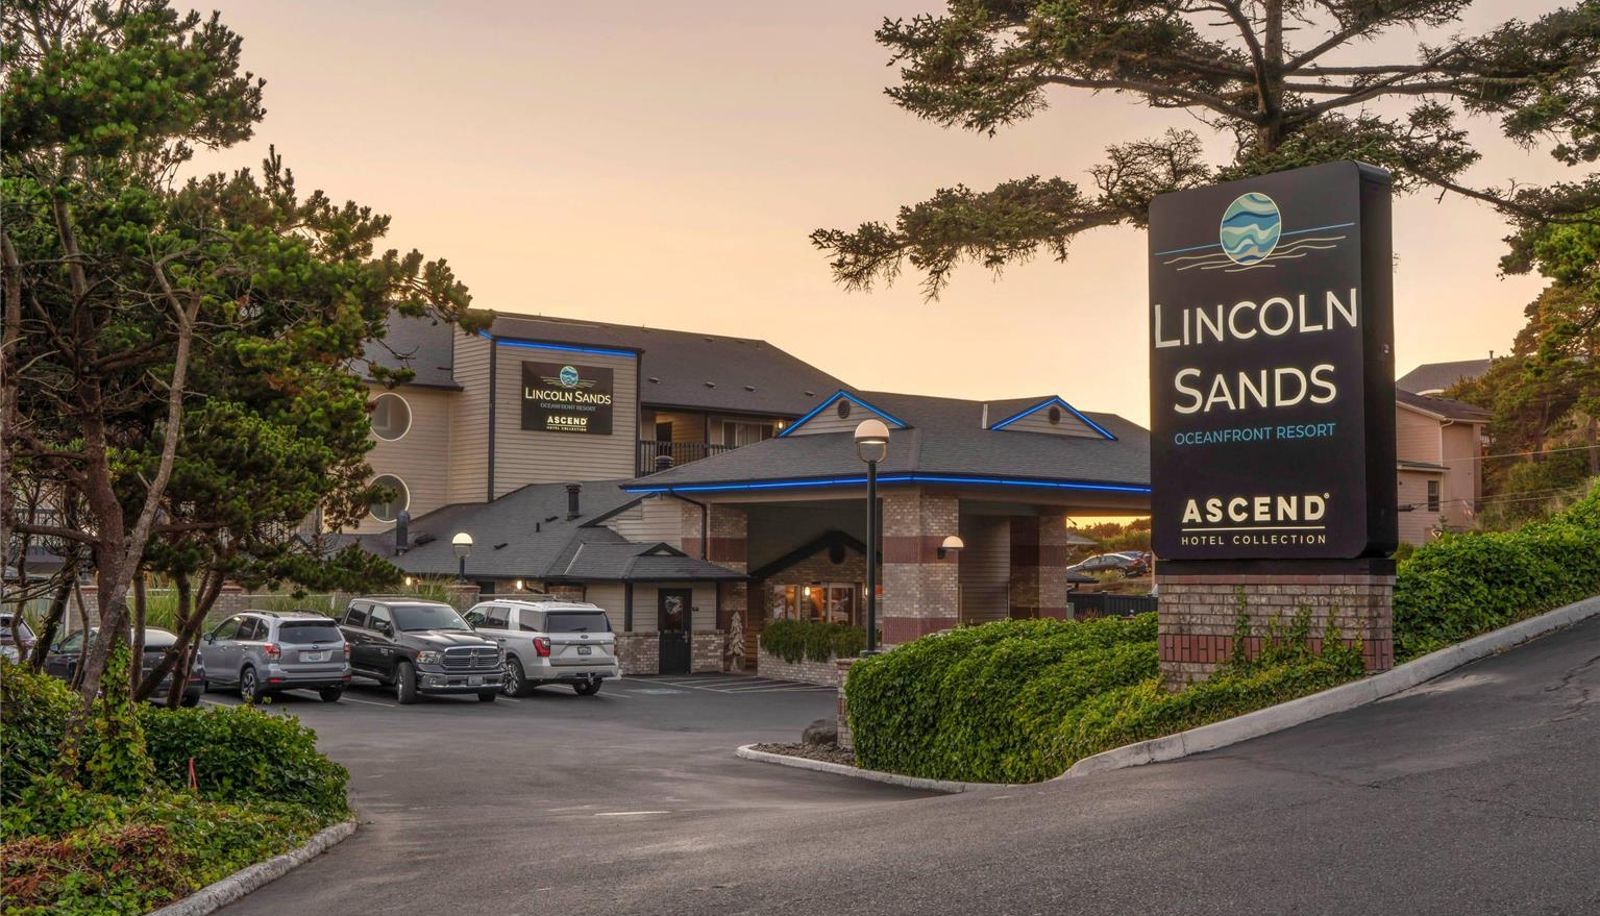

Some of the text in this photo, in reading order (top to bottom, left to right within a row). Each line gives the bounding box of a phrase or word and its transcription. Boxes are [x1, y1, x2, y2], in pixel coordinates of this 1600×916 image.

[1155, 288, 1358, 348] LINCOLN
[525, 387, 611, 405] LINCOLN SANDS
[1174, 364, 1337, 414] SANDS
[1175, 423, 1337, 445] OCEANFRONT RESORT
[1181, 534, 1326, 545] HOTEL COLLECTION
